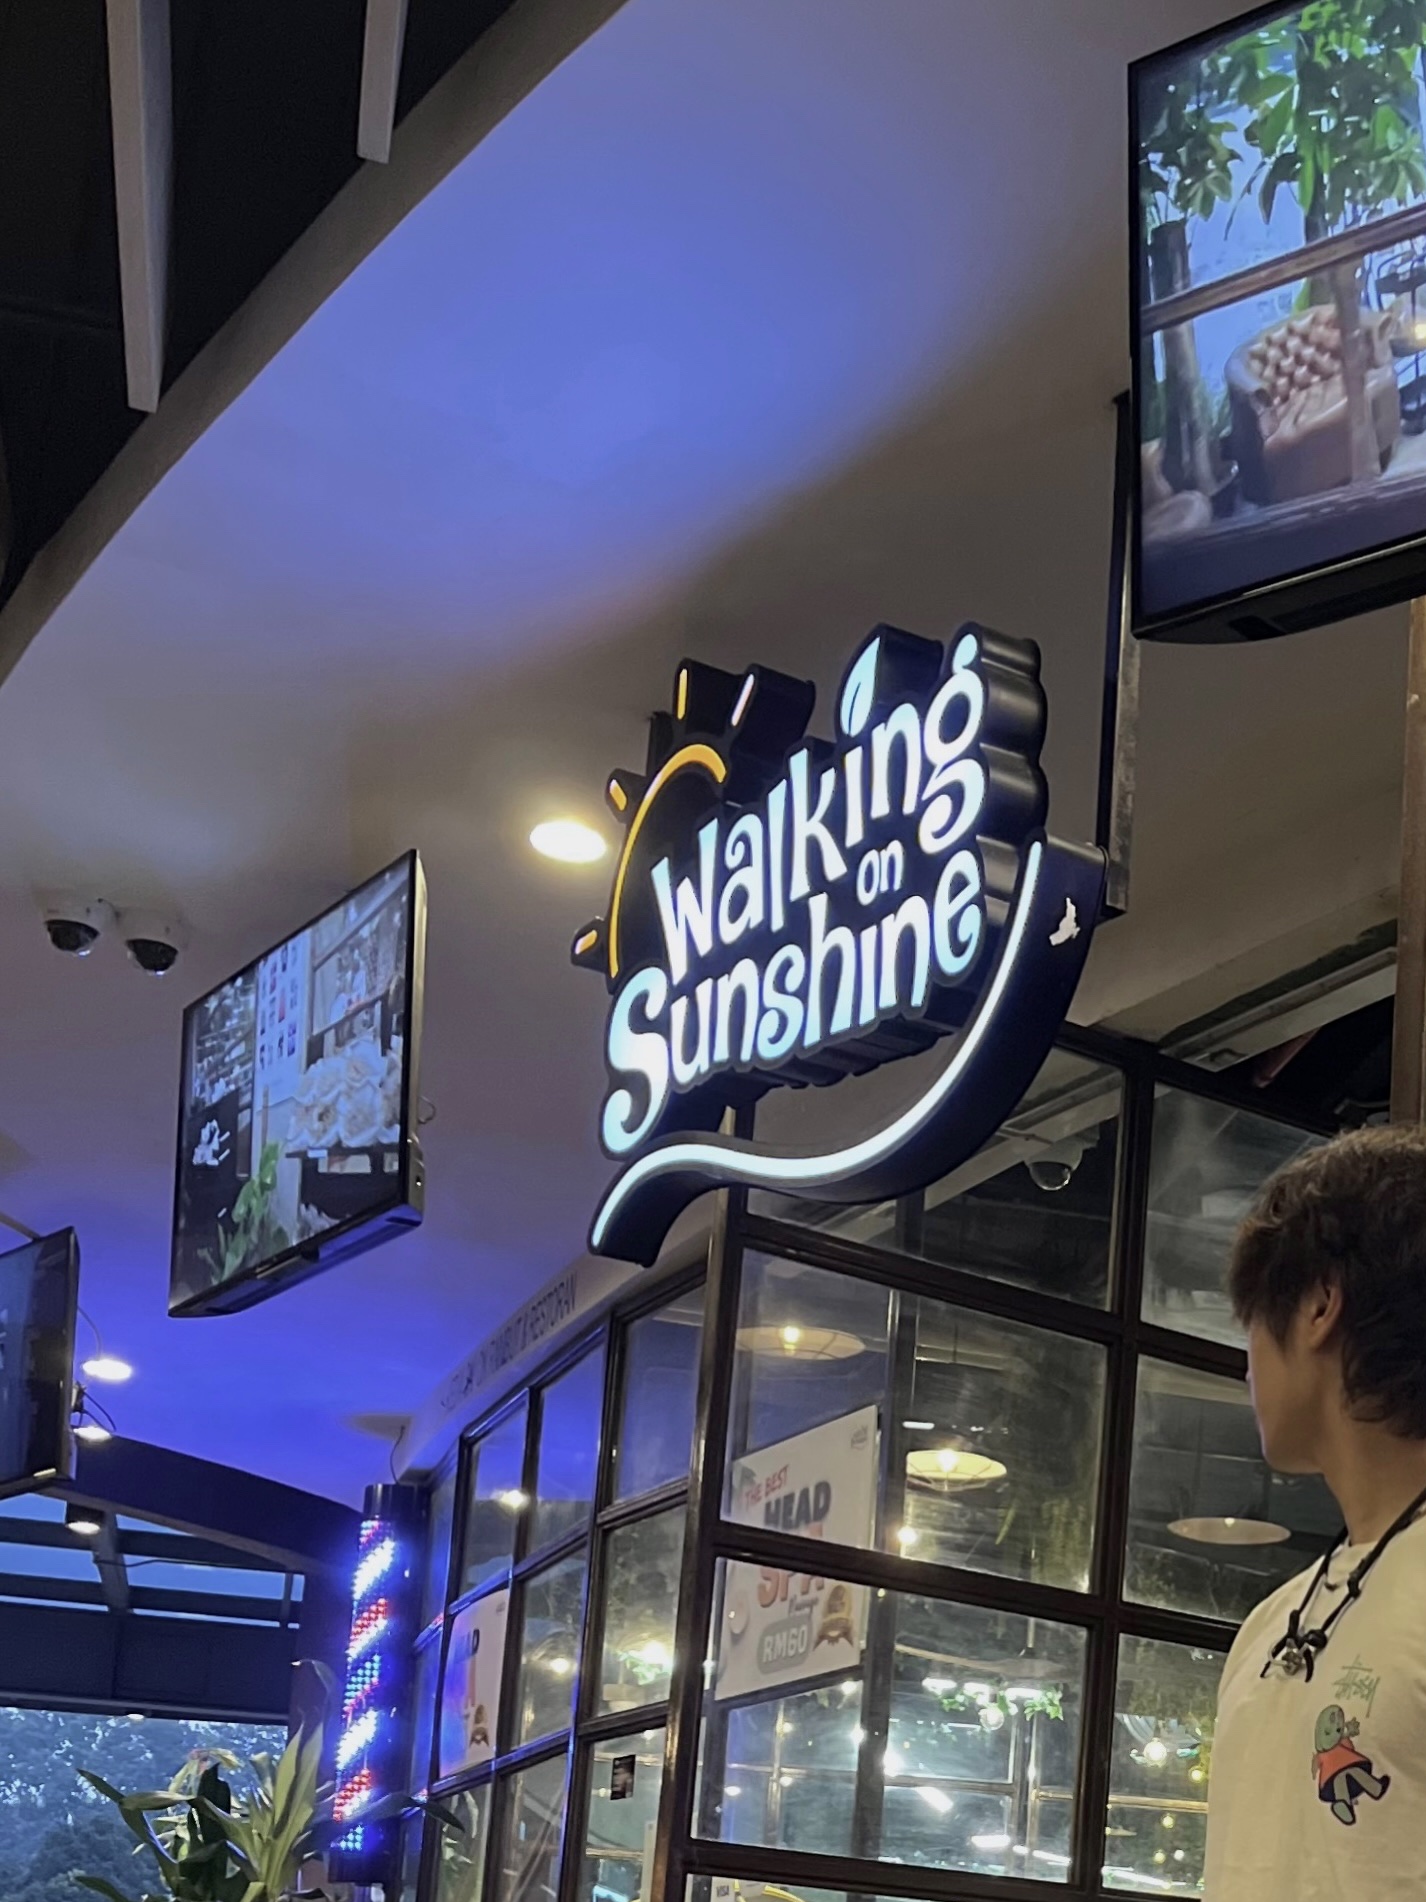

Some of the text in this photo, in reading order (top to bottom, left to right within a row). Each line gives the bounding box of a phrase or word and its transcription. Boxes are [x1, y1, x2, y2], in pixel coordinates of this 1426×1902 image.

[650, 633, 986, 986] Walking
[856, 839, 903, 905] on
[602, 849, 982, 1153] Sunshine
[764, 1480, 832, 1531] HEAD
[765, 1464, 790, 1498] BEST
[762, 1624, 808, 1663] RM60
